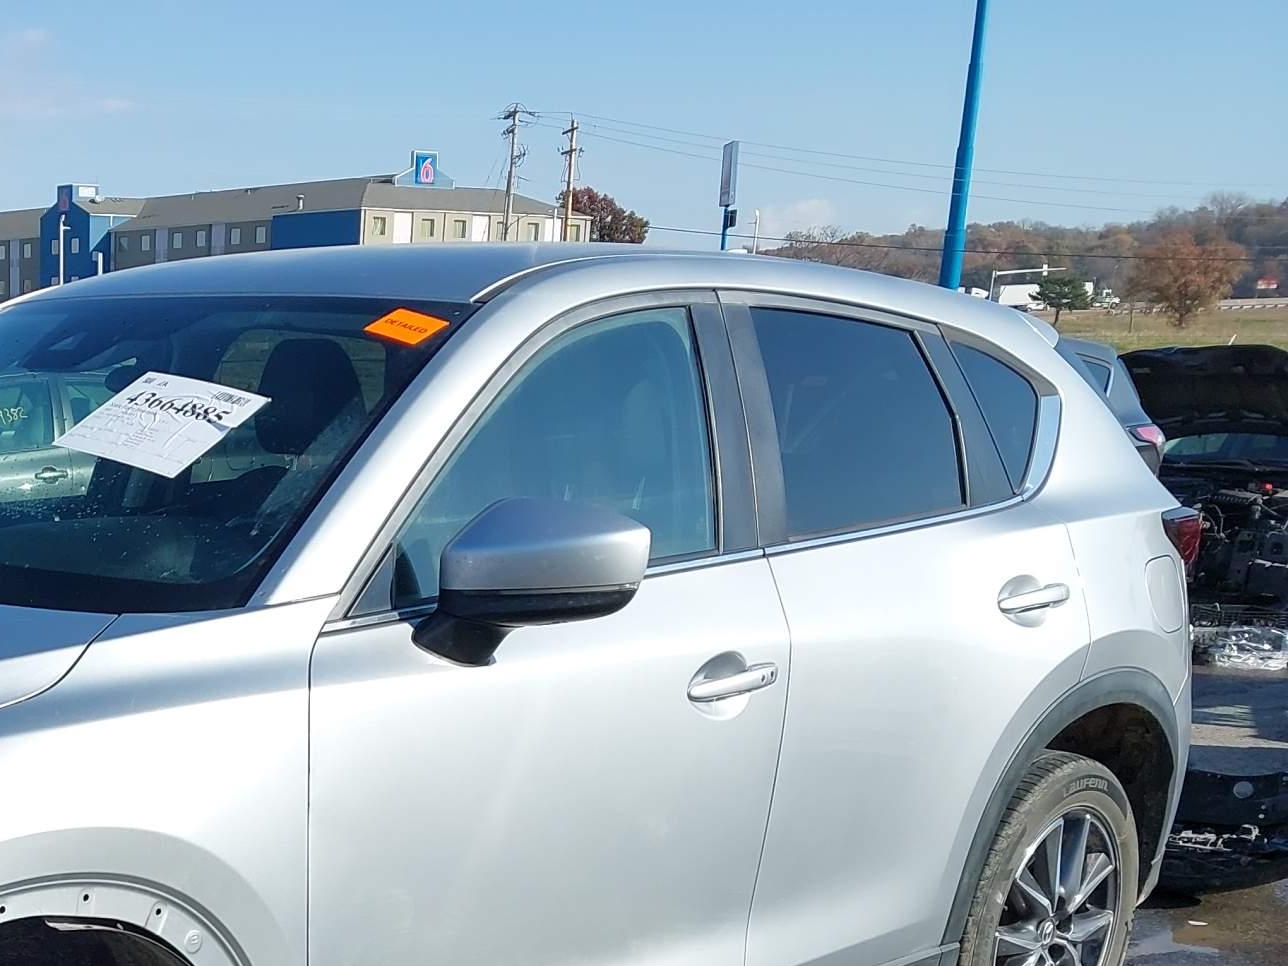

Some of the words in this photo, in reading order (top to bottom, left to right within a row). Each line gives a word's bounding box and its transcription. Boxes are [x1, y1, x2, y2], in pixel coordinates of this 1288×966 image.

[420, 157, 434, 183] 6
[384, 319, 429, 334] DETAILED
[126, 391, 232, 424] 43664885
